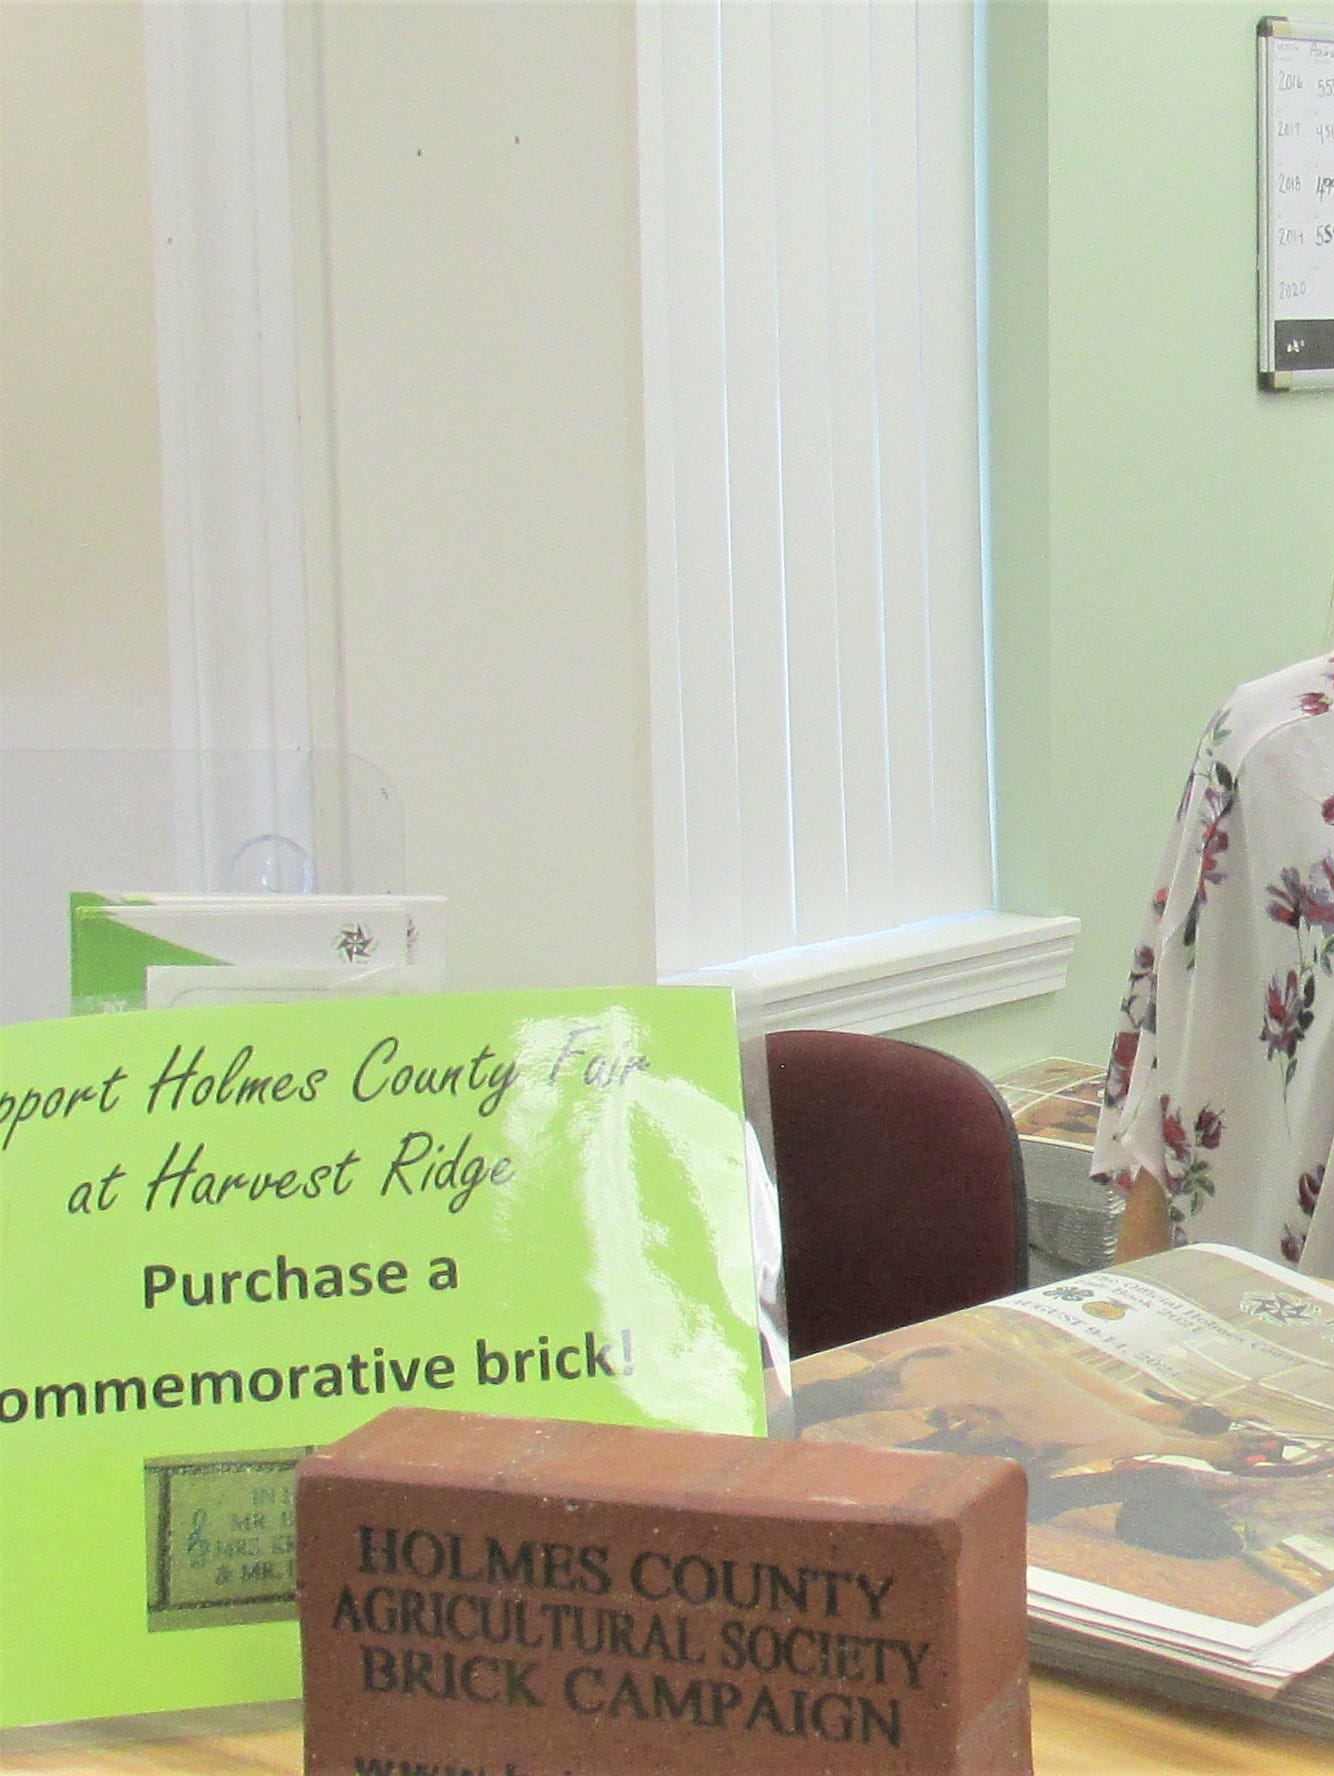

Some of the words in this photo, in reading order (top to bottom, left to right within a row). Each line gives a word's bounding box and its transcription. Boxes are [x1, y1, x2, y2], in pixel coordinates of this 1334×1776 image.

[1279, 71, 1302, 91] 2016
[1278, 121, 1300, 137] 2017
[1279, 173, 1301, 194] 2018
[1279, 281, 1306, 300] 2020
[147, 1044, 329, 1114] Holmes
[352, 1036, 521, 1117] County
[549, 1026, 650, 1087] Fair
[67, 1163, 128, 1214] at
[146, 1141, 361, 1212] Harvest
[380, 1130, 516, 1214] Ridge
[143, 1253, 409, 1309] Purchase
[429, 1255, 459, 1290] a
[475, 1328, 636, 1386] brick!
[358, 1524, 612, 1595] HOLMES
[630, 1551, 896, 1621] COUNTY
[331, 1584, 705, 1665] AGRICULTURAL
[721, 1620, 933, 1691] SOCIETY
[360, 1644, 546, 1708] BRICK
[564, 1666, 901, 1748] CAMPAIGN
